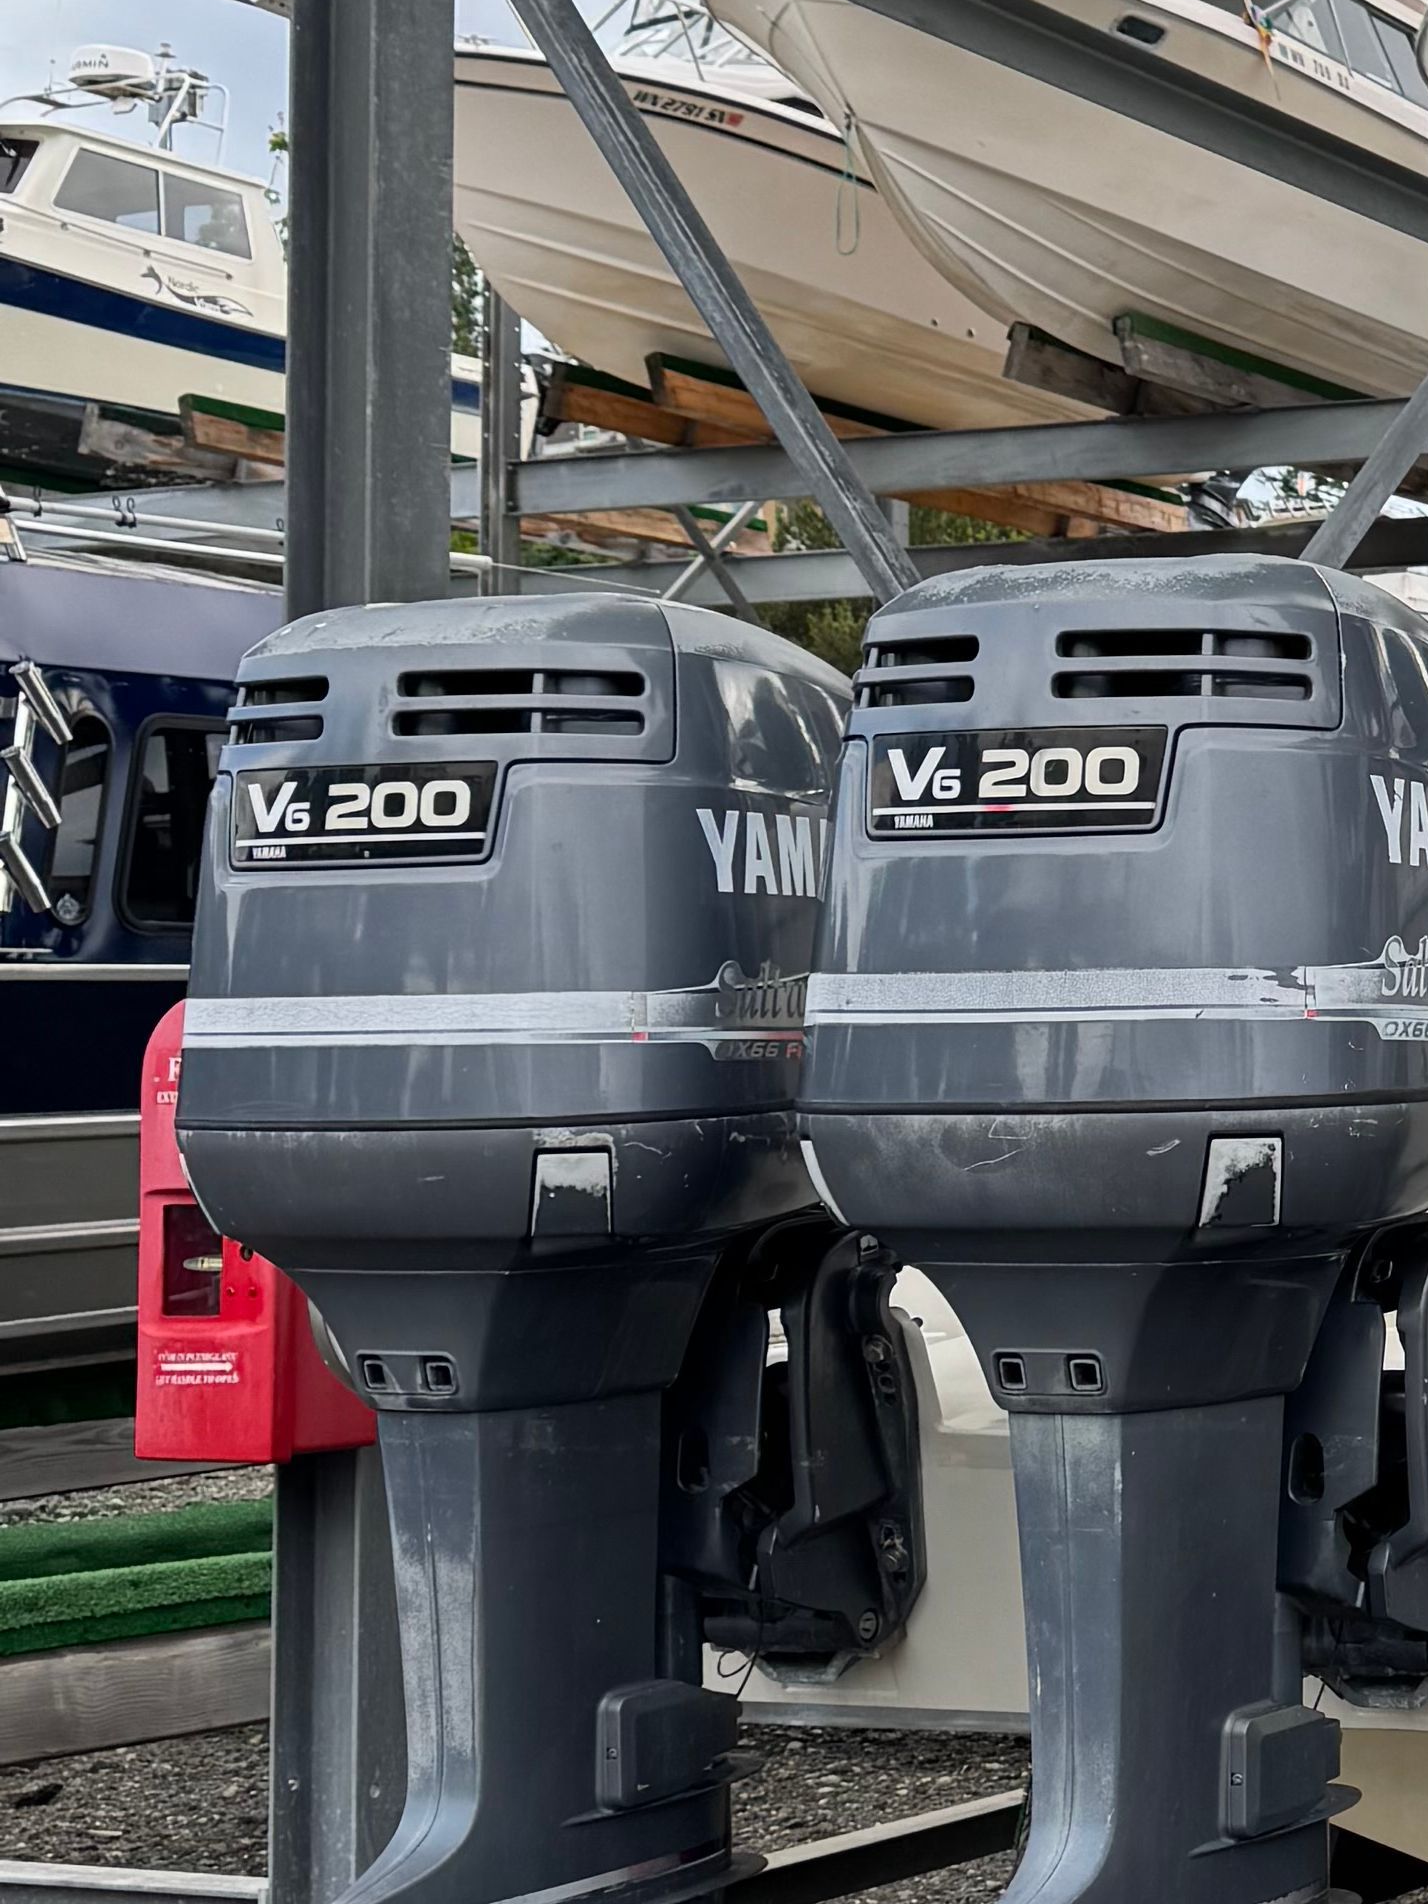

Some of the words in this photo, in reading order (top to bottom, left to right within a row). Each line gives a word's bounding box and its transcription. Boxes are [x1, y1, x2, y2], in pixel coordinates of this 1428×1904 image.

[887, 746, 961, 801] V6
[978, 746, 1140, 798] 200
[247, 781, 311, 833] V6
[325, 779, 471, 831] 200
[894, 814, 934, 830] YAMAHA
[696, 808, 828, 898] YAM
